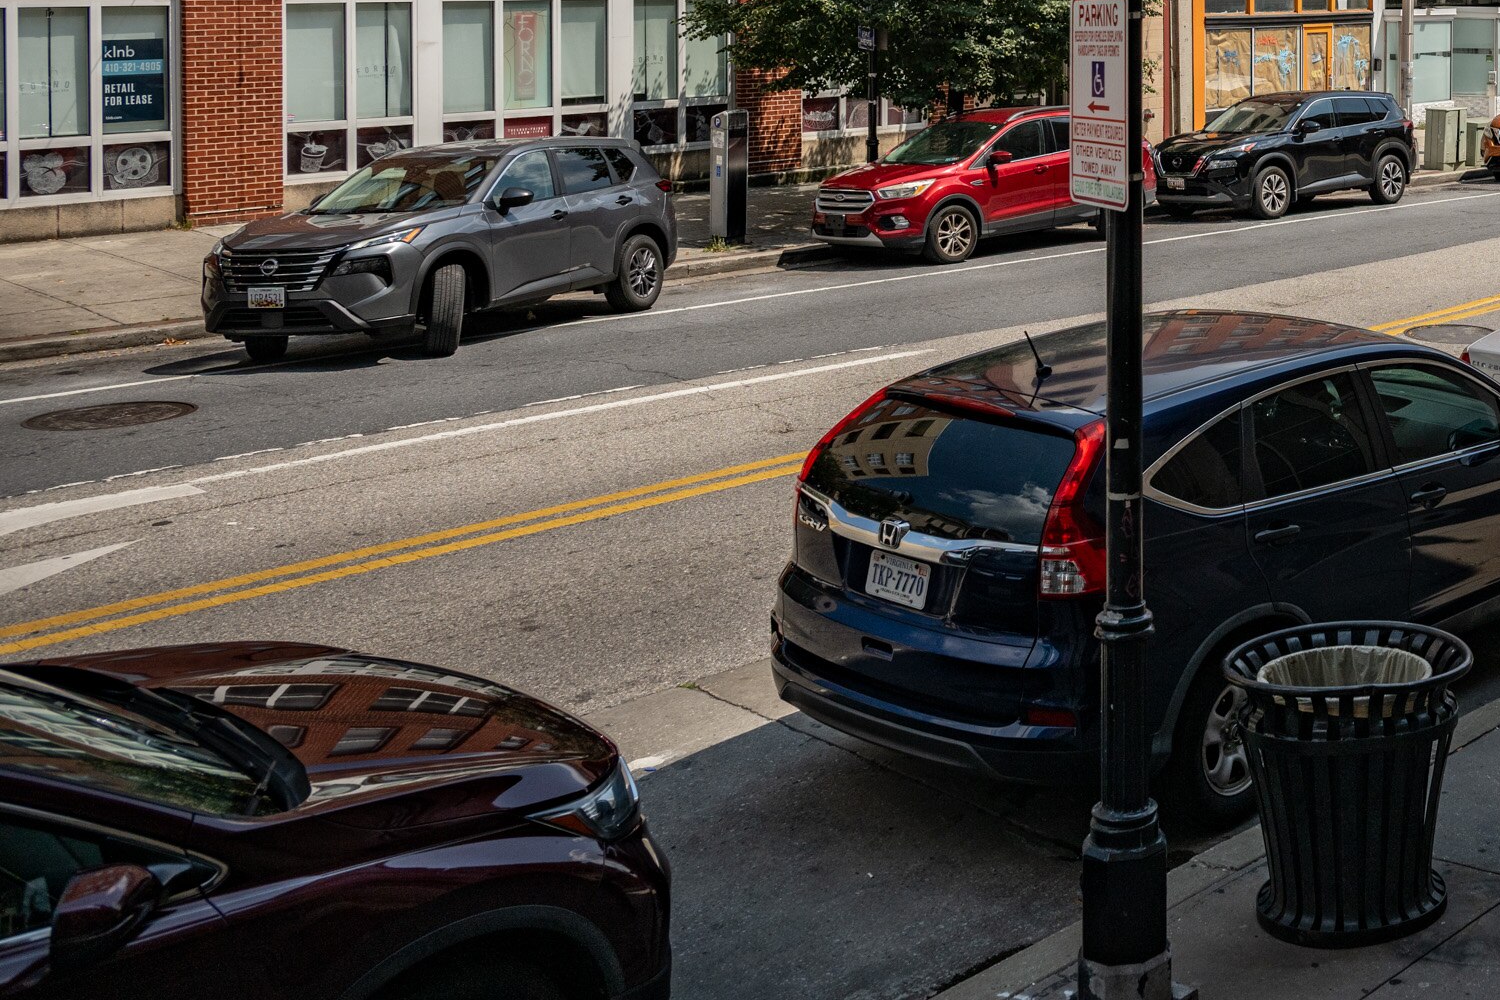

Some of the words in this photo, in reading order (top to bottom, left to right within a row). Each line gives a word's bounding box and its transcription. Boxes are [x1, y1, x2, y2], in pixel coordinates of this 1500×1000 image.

[1079, 3, 1119, 27] PARKING
[104, 45, 136, 58] klnb
[105, 61, 161, 73] 410-321-4905
[104, 83, 136, 94] RETAIL
[105, 96, 122, 106] FOR
[125, 94, 153, 105] LEASE
[1076, 145, 1094, 157] OTHER
[1095, 147, 1122, 162] VEHICLES
[1081, 160, 1099, 174] TOWED
[1100, 163, 1117, 177] AWAY
[885, 556, 914, 571] VIRGINIA
